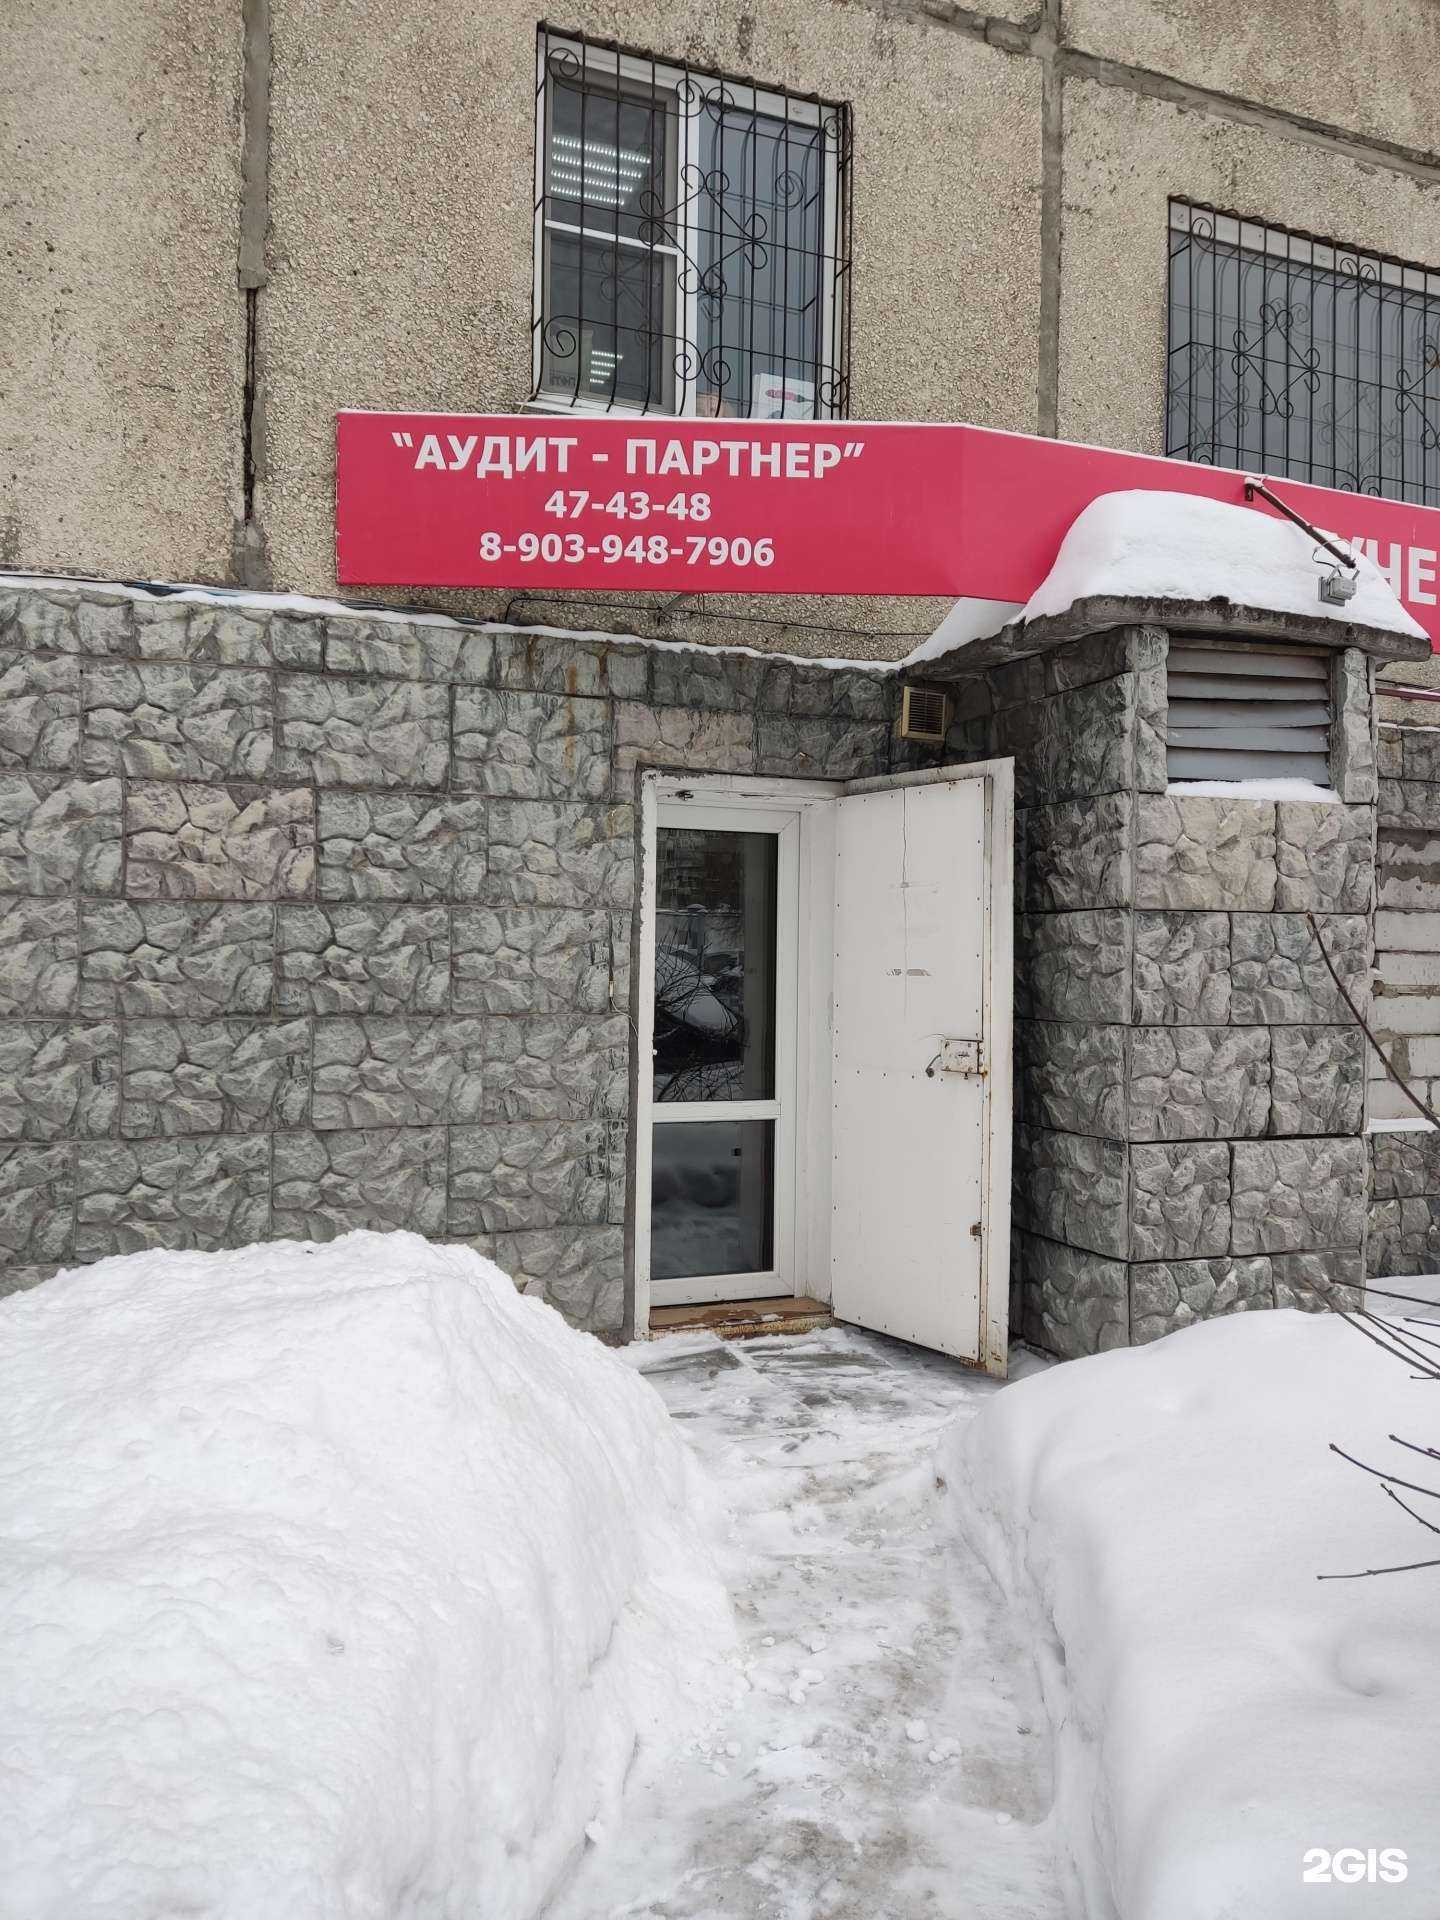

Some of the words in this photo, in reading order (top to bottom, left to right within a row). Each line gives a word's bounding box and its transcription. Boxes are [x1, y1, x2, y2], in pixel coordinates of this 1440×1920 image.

[544, 490, 712, 522] 47-43-48
[479, 531, 775, 567] 8-903-948-7906
[1351, 536, 1438, 605] ЧЕ
